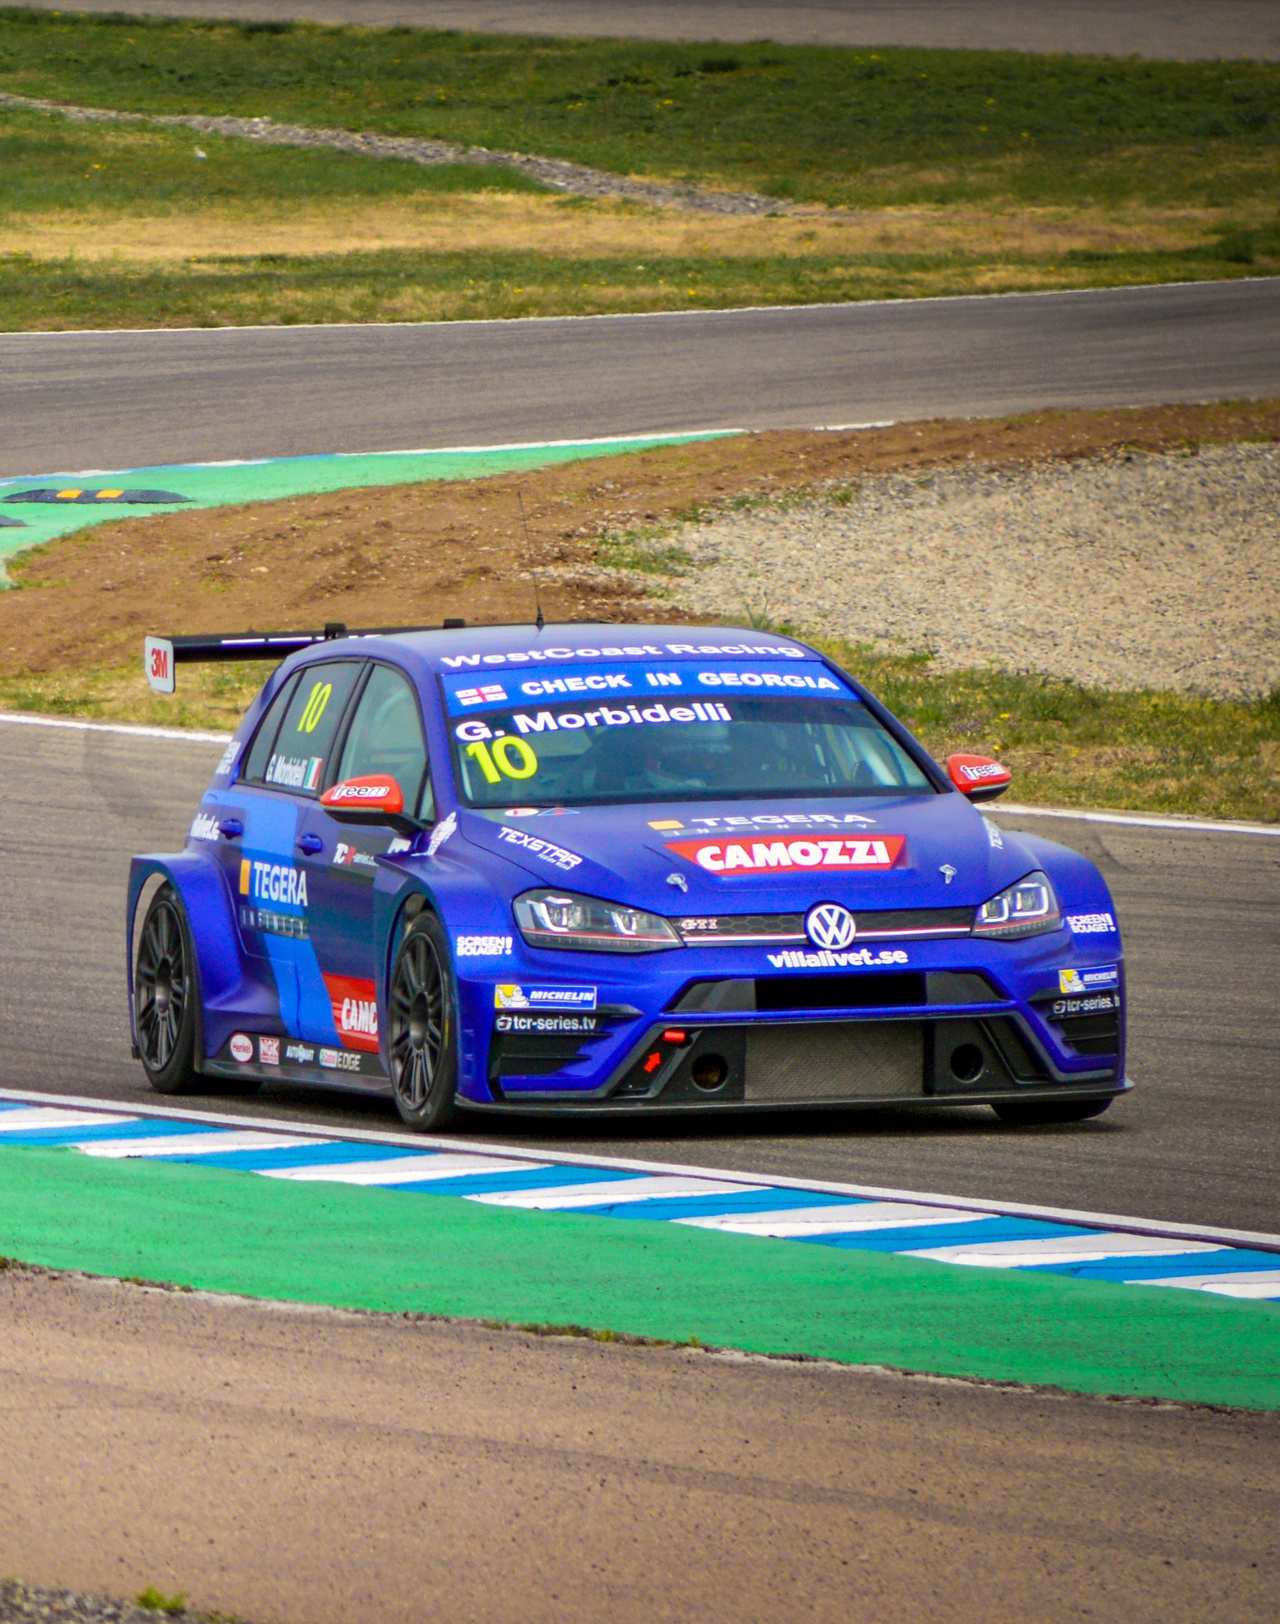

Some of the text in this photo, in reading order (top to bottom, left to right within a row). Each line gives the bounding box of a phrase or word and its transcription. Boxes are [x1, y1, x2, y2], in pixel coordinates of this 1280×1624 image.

[151, 648, 168, 679] 3M
[440, 644, 805, 667] WestCoast Racing
[521, 672, 841, 695] CHECK IN GEORGIA
[297, 681, 332, 733] 10
[455, 703, 733, 742] G. Morbidelli
[465, 735, 539, 784] 10
[331, 784, 389, 800] freem
[673, 823, 870, 836] INFINITY
[690, 814, 877, 827] TEGERA
[497, 826, 583, 868] TEXSTAR
[696, 840, 891, 871] CAMOZZI
[254, 862, 308, 906] TEGERA
[242, 909, 305, 936] INFINITY
[681, 918, 718, 930] GTI
[457, 936, 505, 946] SCREEN
[767, 949, 909, 968] villalivet.se
[529, 990, 594, 1001] MICHELIN
[513, 1015, 597, 1030] tcr-series.tv
[261, 1039, 279, 1056] NGK
[337, 1052, 362, 1071] EDGE
